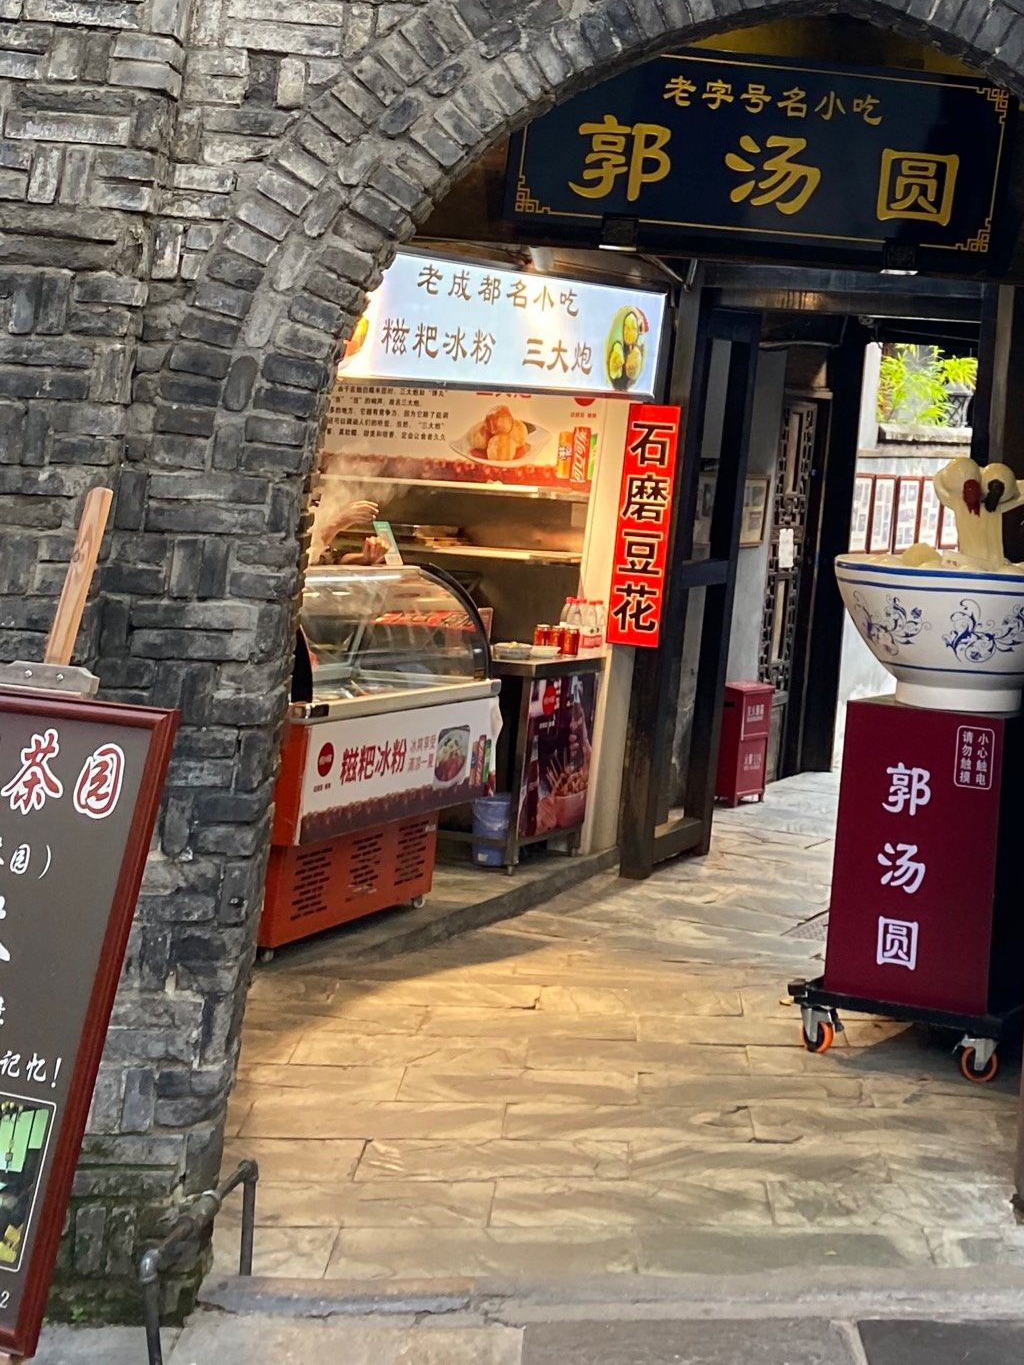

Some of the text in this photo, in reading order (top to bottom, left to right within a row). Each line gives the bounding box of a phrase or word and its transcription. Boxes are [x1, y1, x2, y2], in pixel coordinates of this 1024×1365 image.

[662, 75, 883, 127] 老字号名小吃
[567, 114, 961, 227] 郭汤圆
[417, 263, 580, 317] 老成都名小吃
[381, 318, 593, 375] 糍粑冰粉 三大炮
[611, 421, 675, 633] 石磨豆花
[340, 738, 407, 786] 糍粑冰粉
[959, 730, 974, 784] 请勿触摸
[975, 732, 990, 786] 小心触电
[876, 762, 932, 971] 郭汤圆
